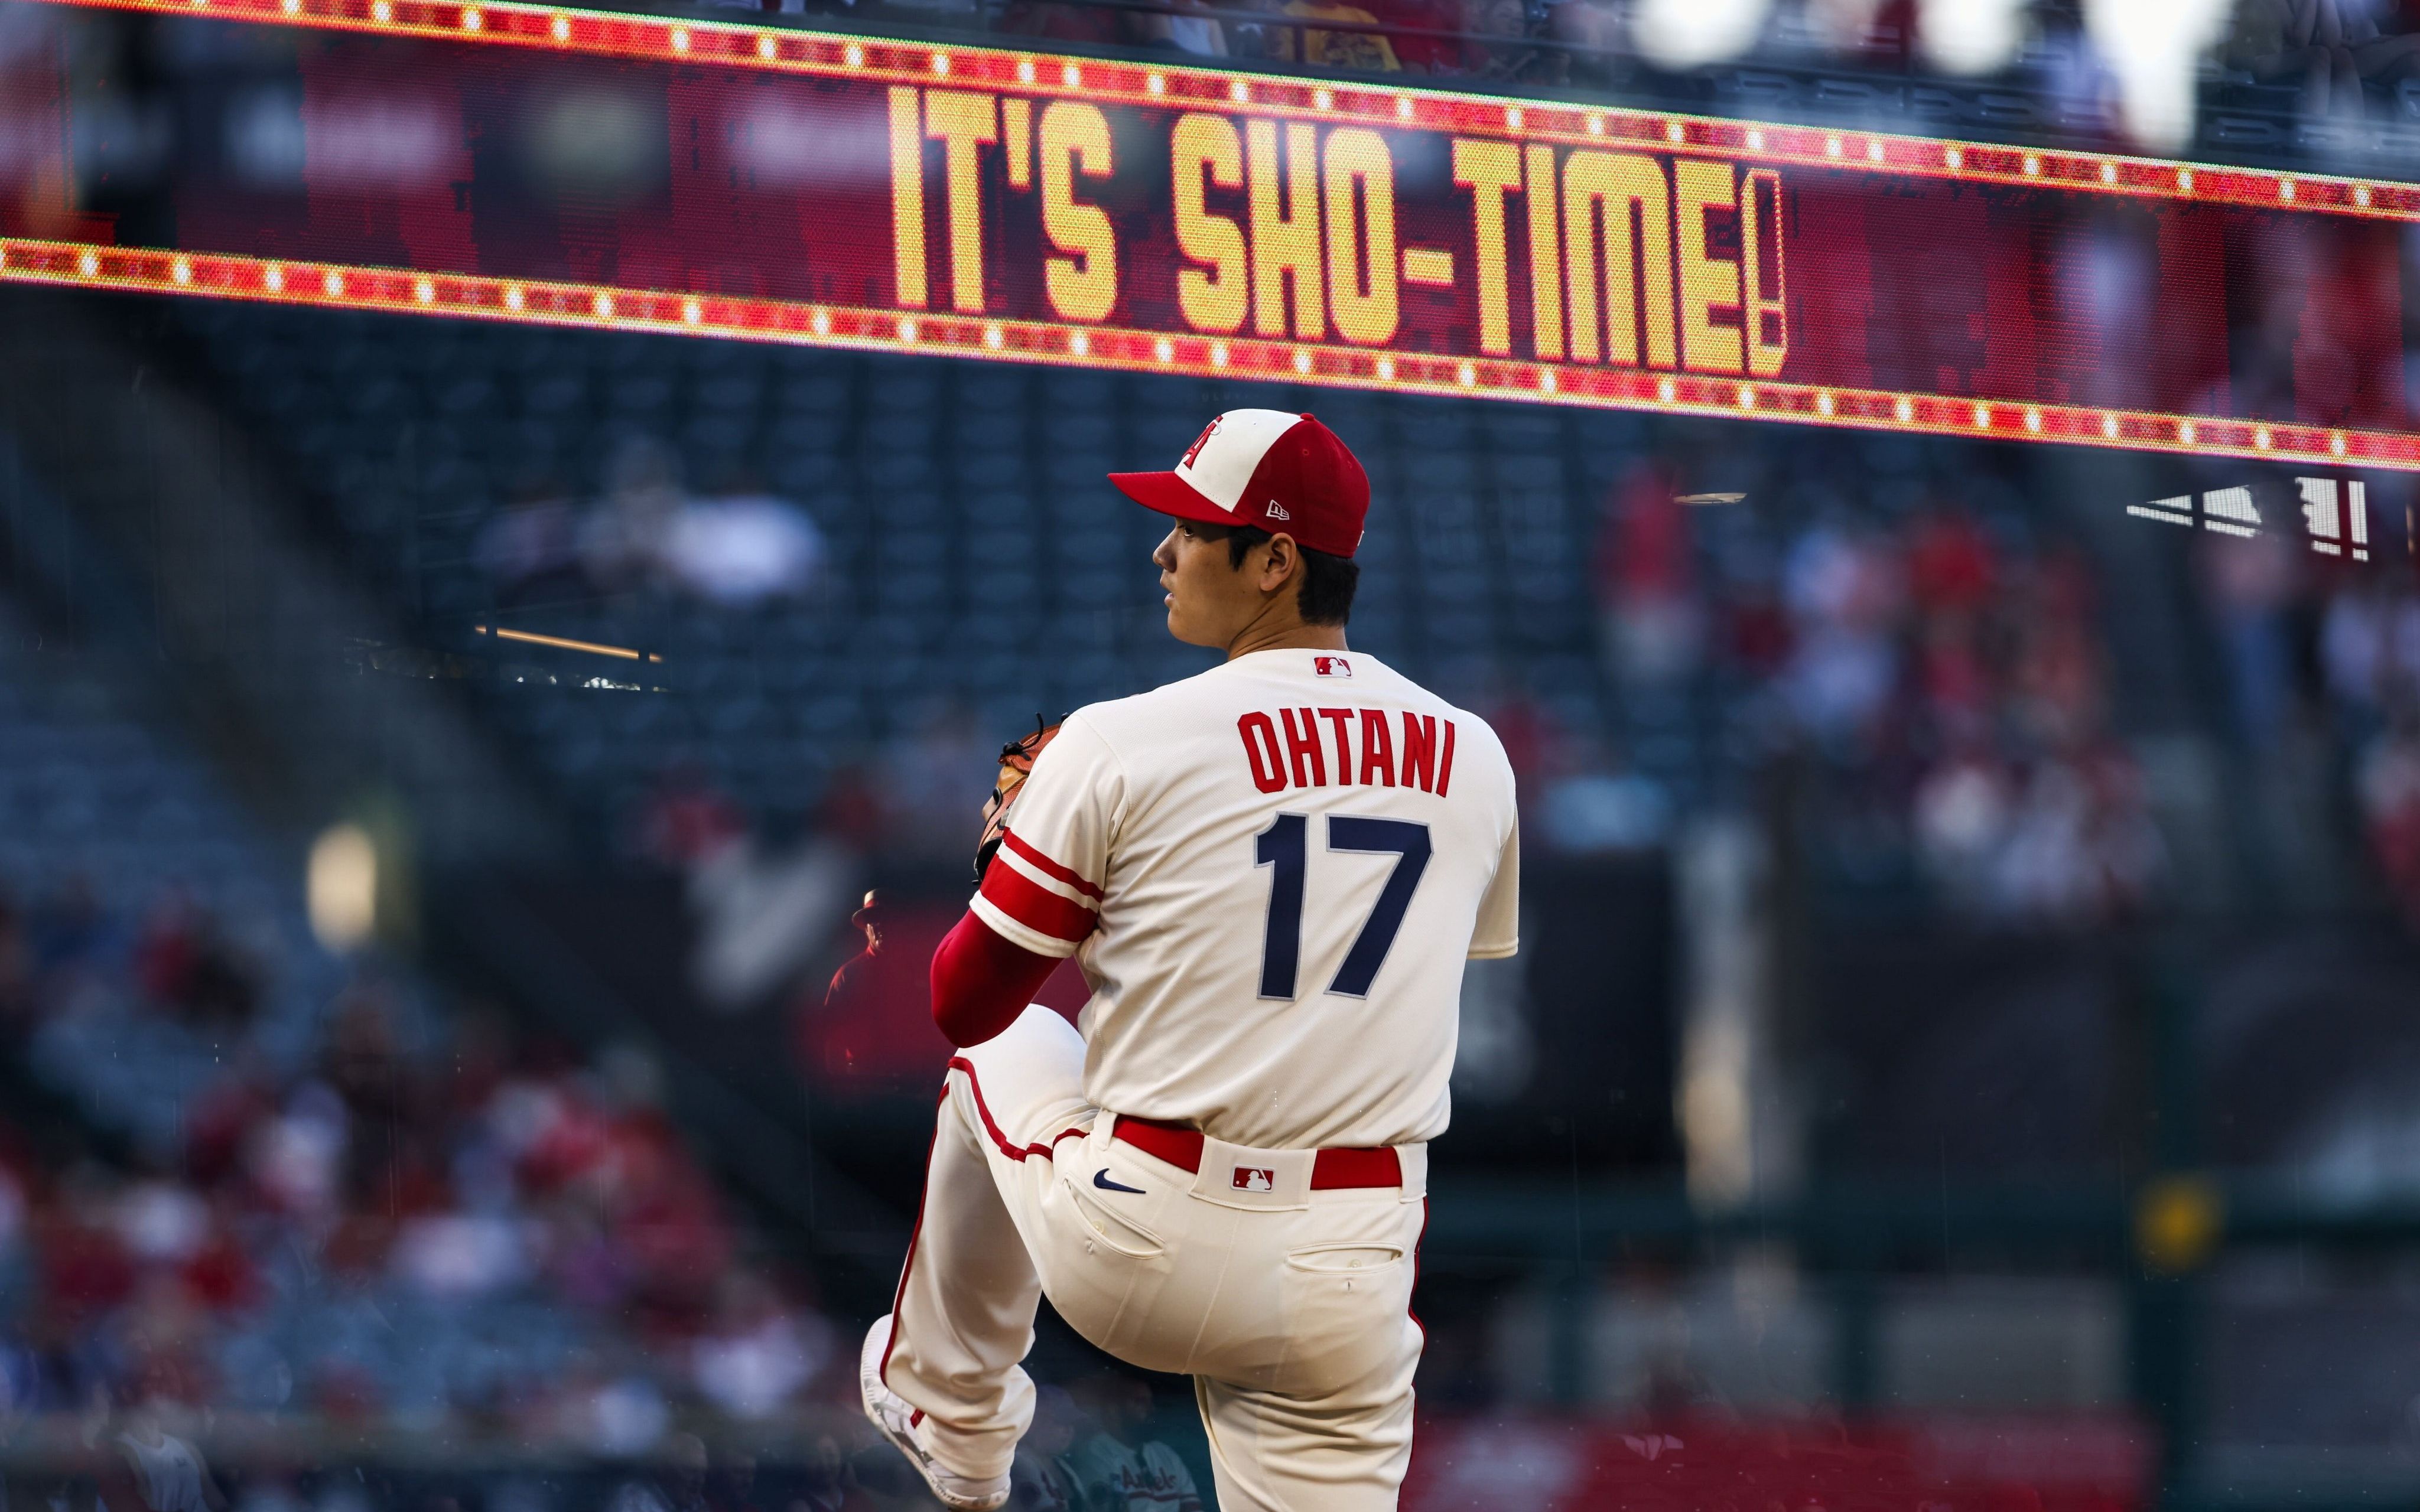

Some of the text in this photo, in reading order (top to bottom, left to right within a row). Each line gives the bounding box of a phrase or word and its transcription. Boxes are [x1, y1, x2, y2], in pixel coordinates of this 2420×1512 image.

[887, 85, 1788, 378] IT'S SHO-TIME!
[1182, 415, 1224, 471] A
[1237, 708, 1455, 797] OHTANI
[1254, 811, 1434, 1002] 17
